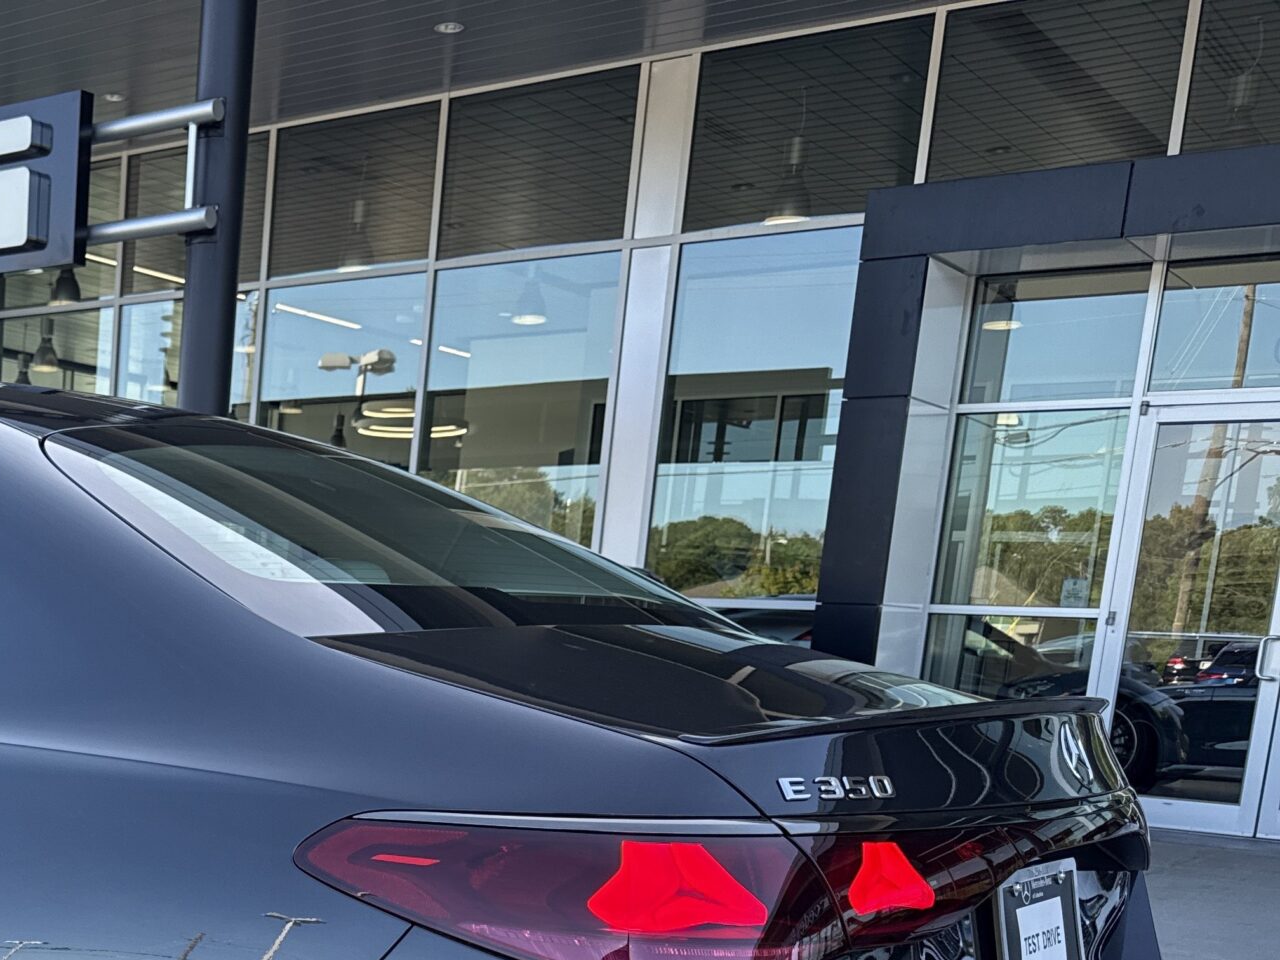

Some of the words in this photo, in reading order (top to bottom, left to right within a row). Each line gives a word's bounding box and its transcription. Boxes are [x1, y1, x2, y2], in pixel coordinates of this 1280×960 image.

[777, 777, 812, 801] E
[813, 776, 896, 800] 350
[1023, 932, 1041, 956] TEST
[1041, 925, 1062, 950] DRIVE
